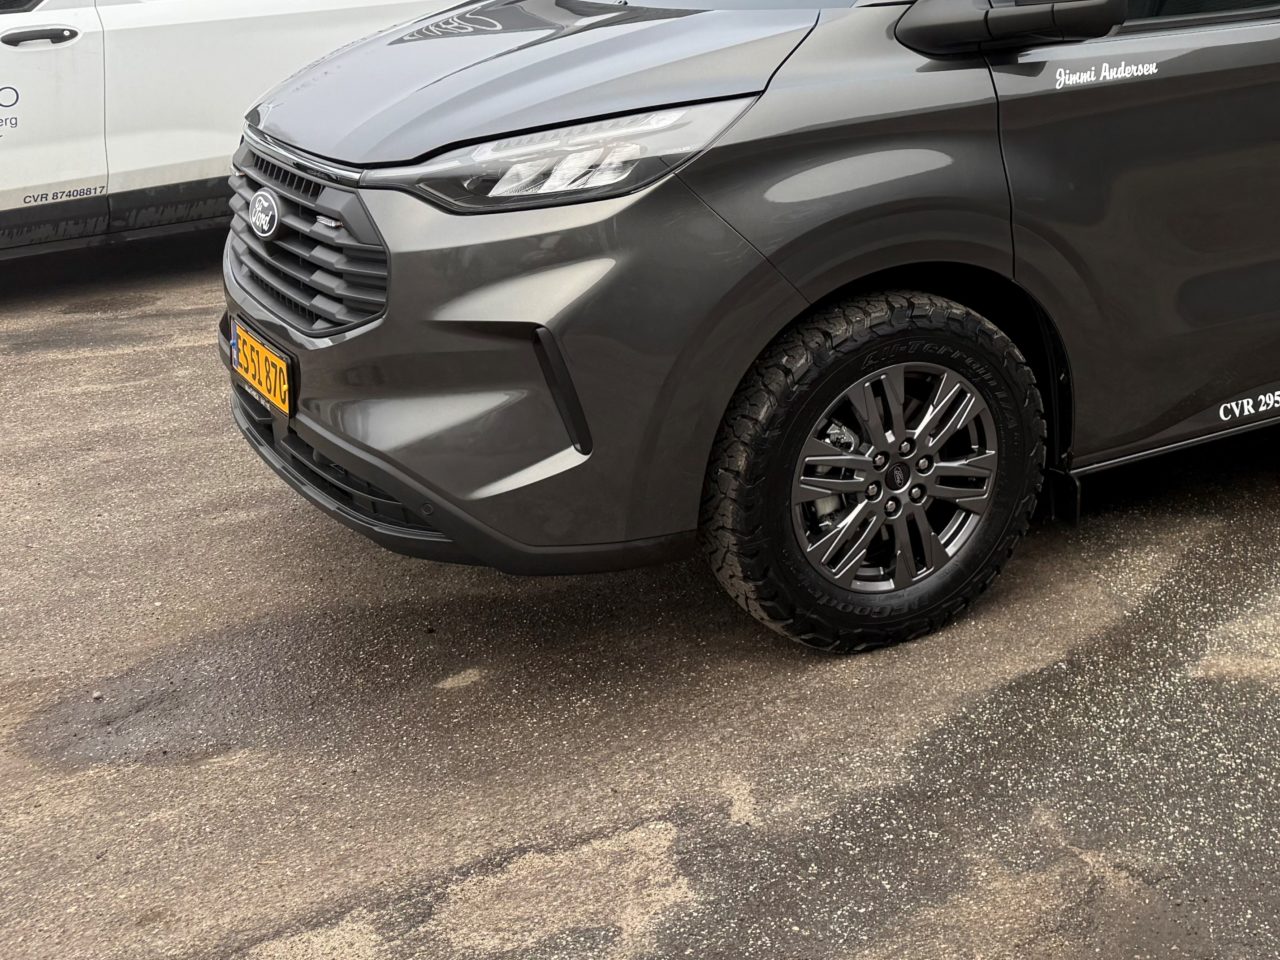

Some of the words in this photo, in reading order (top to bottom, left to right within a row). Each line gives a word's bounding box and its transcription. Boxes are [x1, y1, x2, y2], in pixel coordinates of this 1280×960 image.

[1055, 66, 1096, 89] Jimmi
[1099, 61, 1158, 80] Andersen
[23, 193, 48, 204] CVR
[52, 185, 105, 200] 87408817
[251, 196, 273, 231] Ford
[250, 343, 263, 387] 51
[1219, 398, 1255, 421] CVR
